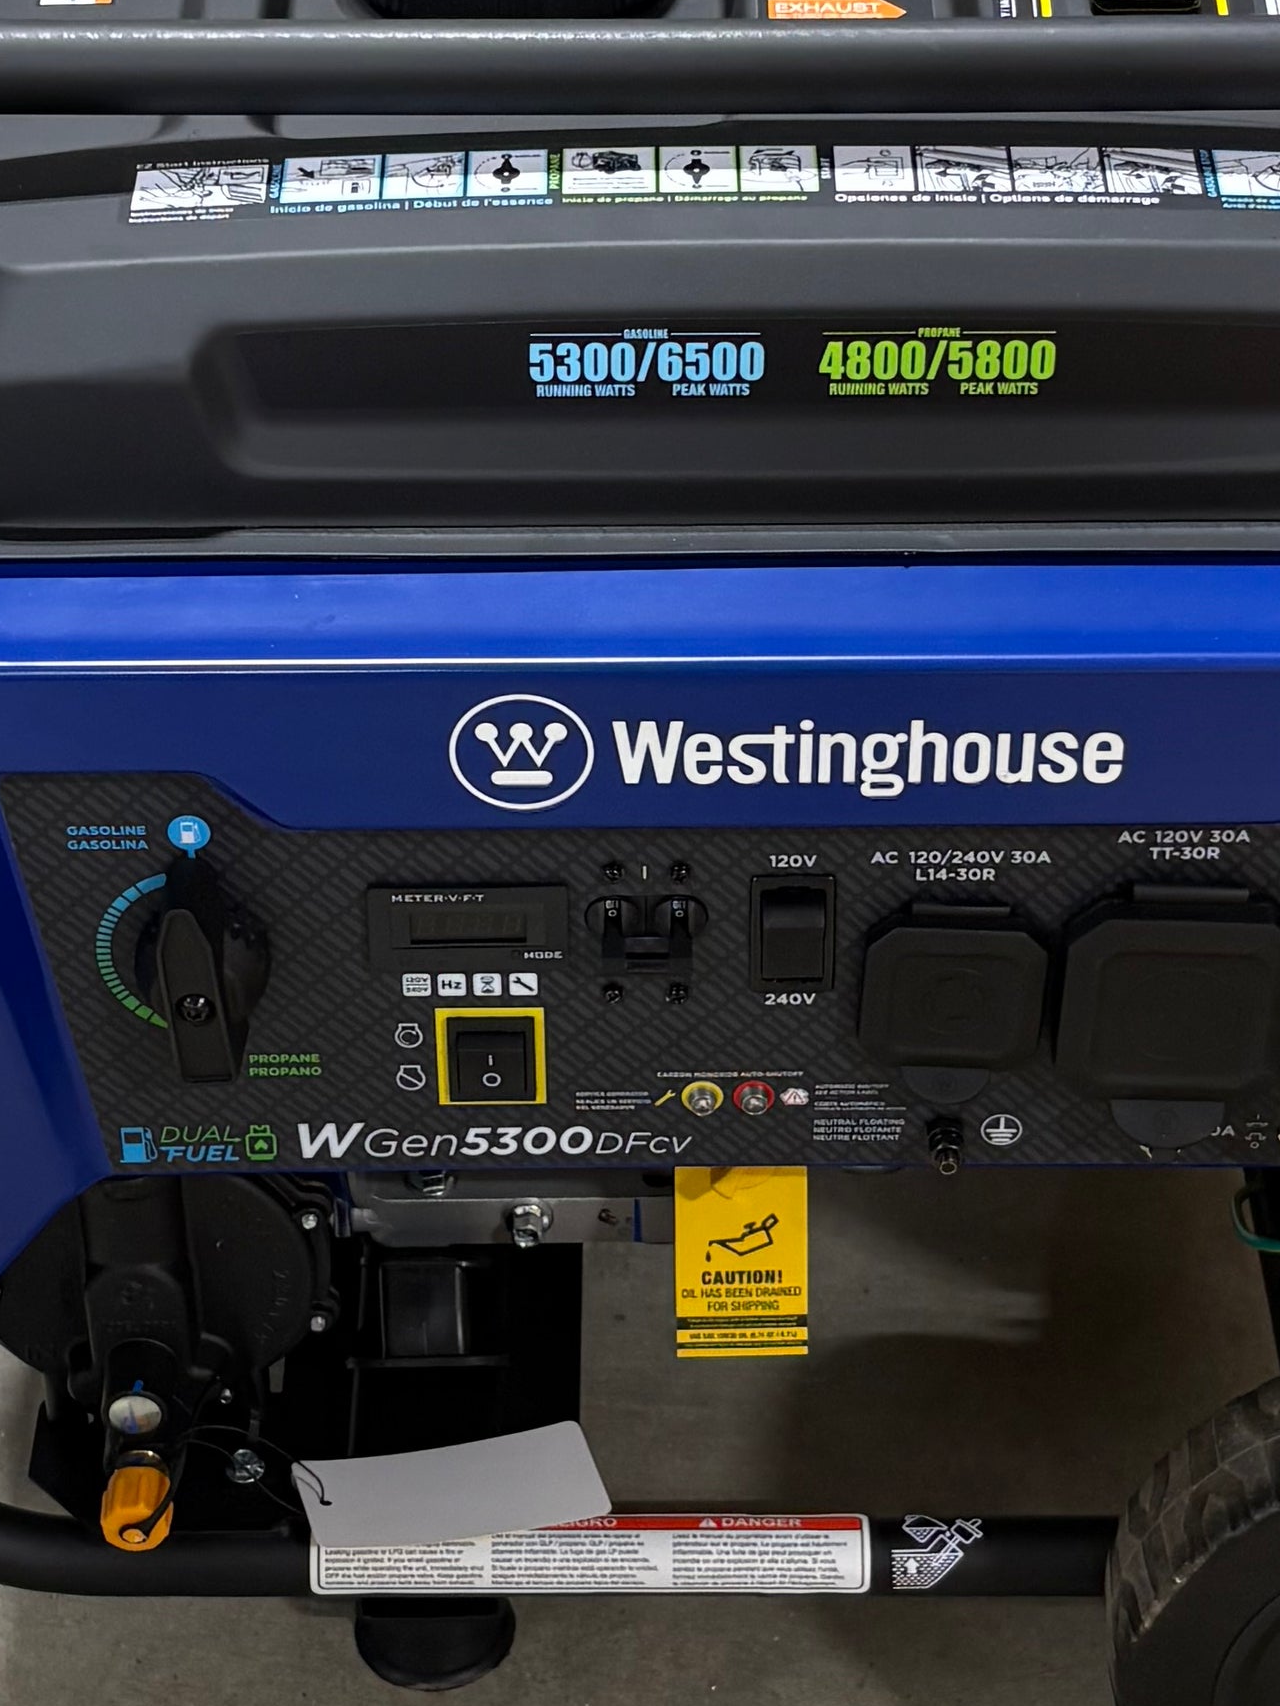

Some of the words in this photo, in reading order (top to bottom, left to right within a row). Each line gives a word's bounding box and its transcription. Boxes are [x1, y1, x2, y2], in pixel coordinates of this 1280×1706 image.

[774, 2, 882, 14] EXHAUST
[413, 198, 457, 209] Début
[462, 199, 480, 208] de
[483, 198, 553, 206] l'essence
[834, 193, 908, 203] Opciones
[911, 193, 931, 203] de
[935, 193, 977, 202] inicio
[989, 193, 1051, 203] Options
[1054, 194, 1074, 203] de
[1077, 193, 1160, 205] démarrage
[270, 204, 311, 214] Inicio
[315, 204, 333, 213] de
[337, 201, 401, 213] gasolina
[623, 328, 668, 340] GASOLINE
[918, 326, 962, 339] PROPANE
[529, 340, 765, 383] 5300/6500
[819, 339, 1057, 382] 4800/5800
[536, 384, 593, 398] RUNNING
[594, 383, 636, 397] WATTS
[672, 383, 705, 397] PEAK
[708, 382, 750, 396] WATTS
[829, 382, 886, 396] RUNNING
[888, 382, 929, 396] WATTS
[960, 382, 995, 395] PEAK
[997, 381, 1038, 395] WATTS
[611, 719, 1125, 800] Westinghouse
[67, 825, 147, 837] GASOLINE
[1119, 829, 1147, 844] AC
[1154, 829, 1204, 844] 120V
[1209, 829, 1251, 844] 30A
[67, 839, 149, 851] GASOLINA
[870, 850, 899, 865] AC
[907, 849, 1004, 865] 120/240V
[1010, 849, 1052, 865] 30A
[1149, 846, 1221, 860] TT-30R
[769, 854, 818, 868] 120V
[915, 867, 996, 882] L14-30R
[524, 950, 563, 960] MODE
[441, 979, 462, 990] Hz
[764, 992, 816, 1006] 240V
[248, 1053, 320, 1065] PROPANE
[248, 1066, 322, 1077] PROPANO
[813, 1118, 857, 1126] NEUTRAL
[859, 1118, 905, 1126] FLOATING
[160, 1126, 241, 1143] DUAL
[813, 1126, 852, 1134] NEUTRO
[854, 1133, 899, 1141] FLOTTANT
[159, 1145, 240, 1163] FUEL
[701, 1269, 783, 1286] CAUTION!
[682, 1288, 697, 1299] OIL
[700, 1287, 722, 1299] HAS
[725, 1287, 753, 1298] BEEN
[755, 1286, 802, 1298] DRAINED
[707, 1301, 729, 1312] FOR
[731, 1299, 780, 1312] SHIPPING
[721, 1517, 802, 1527] DANGER
